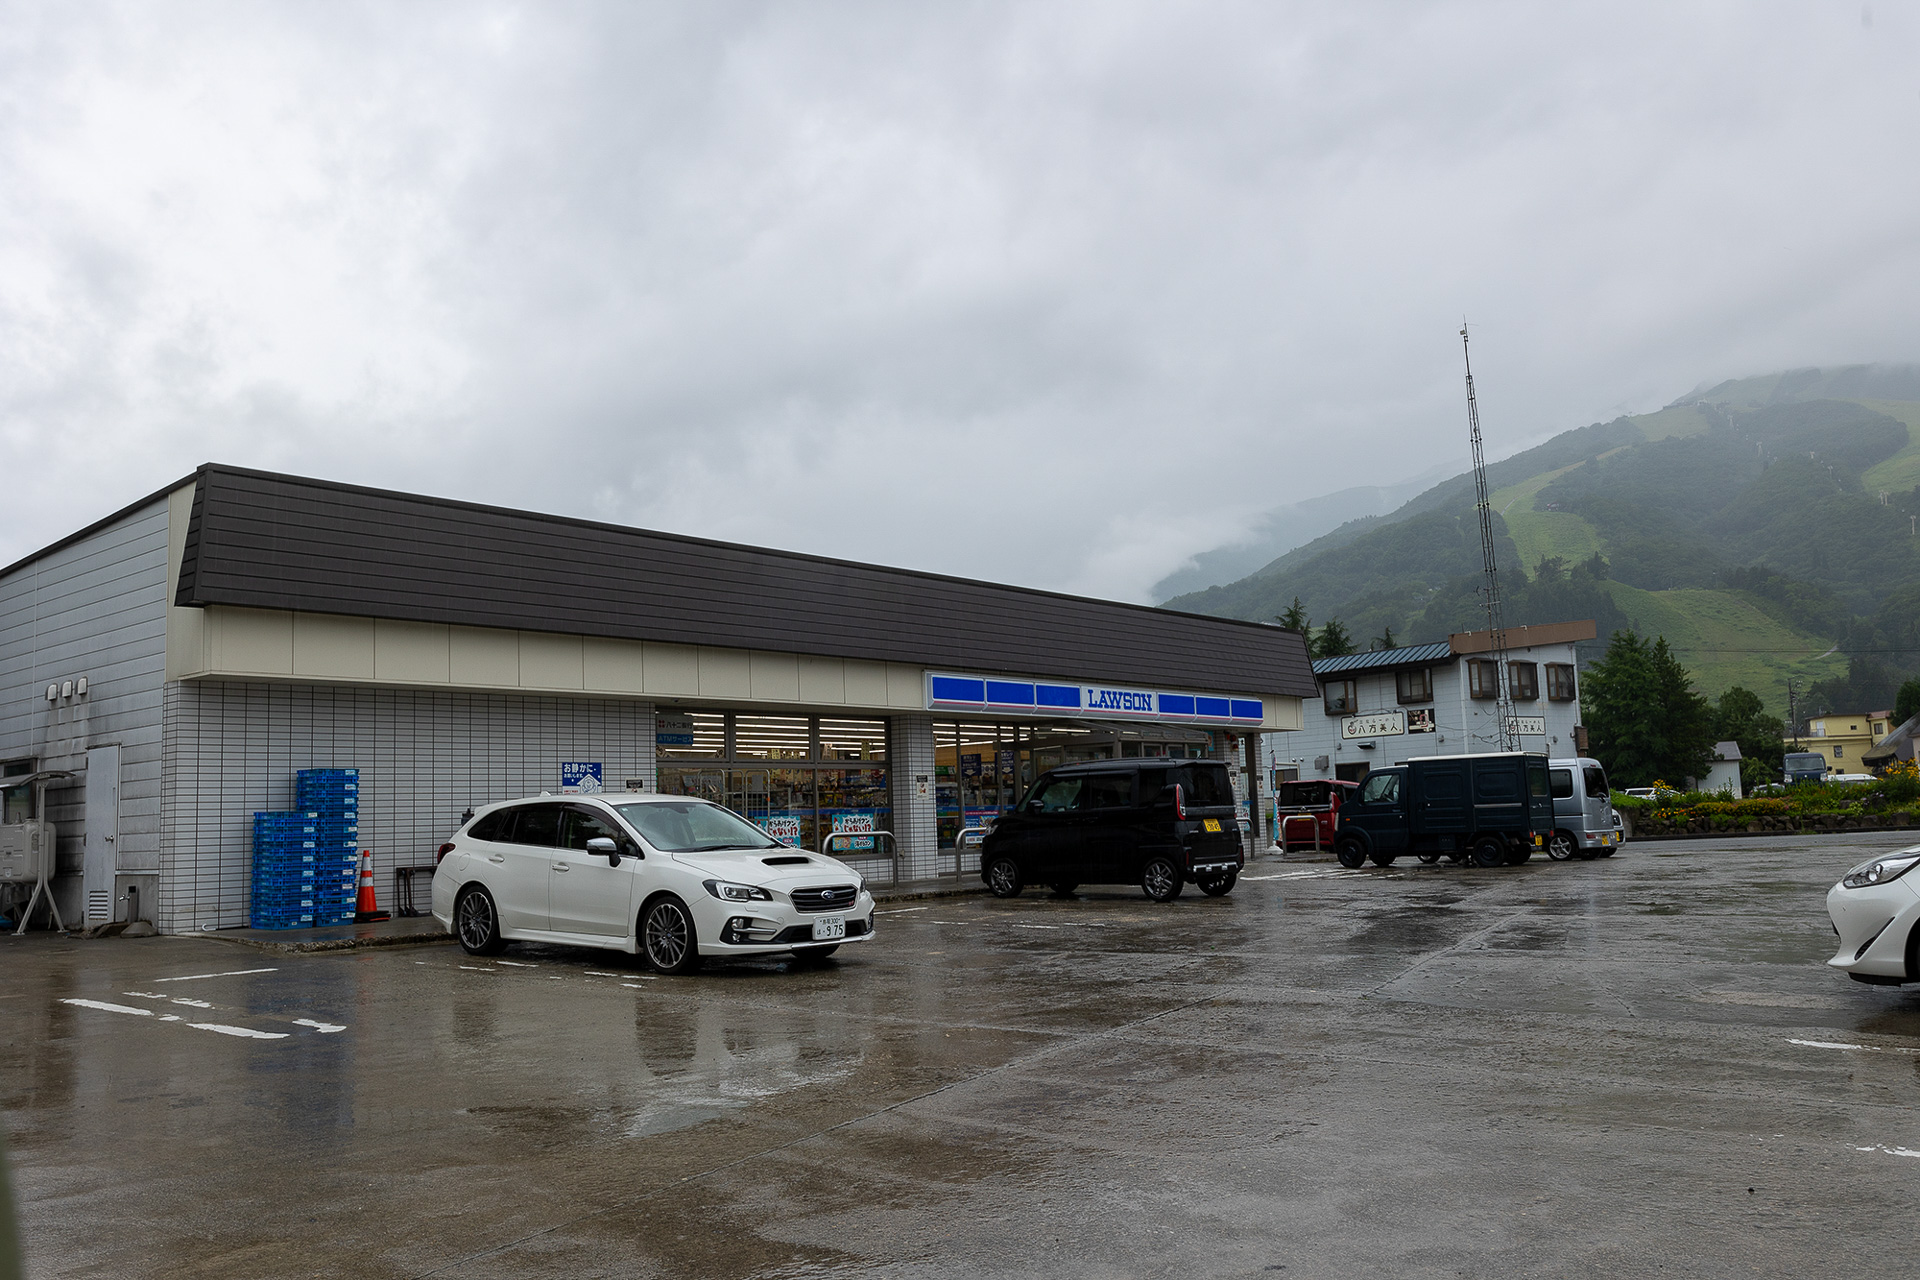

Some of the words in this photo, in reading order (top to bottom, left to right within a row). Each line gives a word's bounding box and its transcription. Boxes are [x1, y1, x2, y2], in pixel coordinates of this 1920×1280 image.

[1088, 689, 1152, 711] LAWSON
[1358, 723, 1398, 734] 八方美人
[658, 735, 693, 743] ATMサービス
